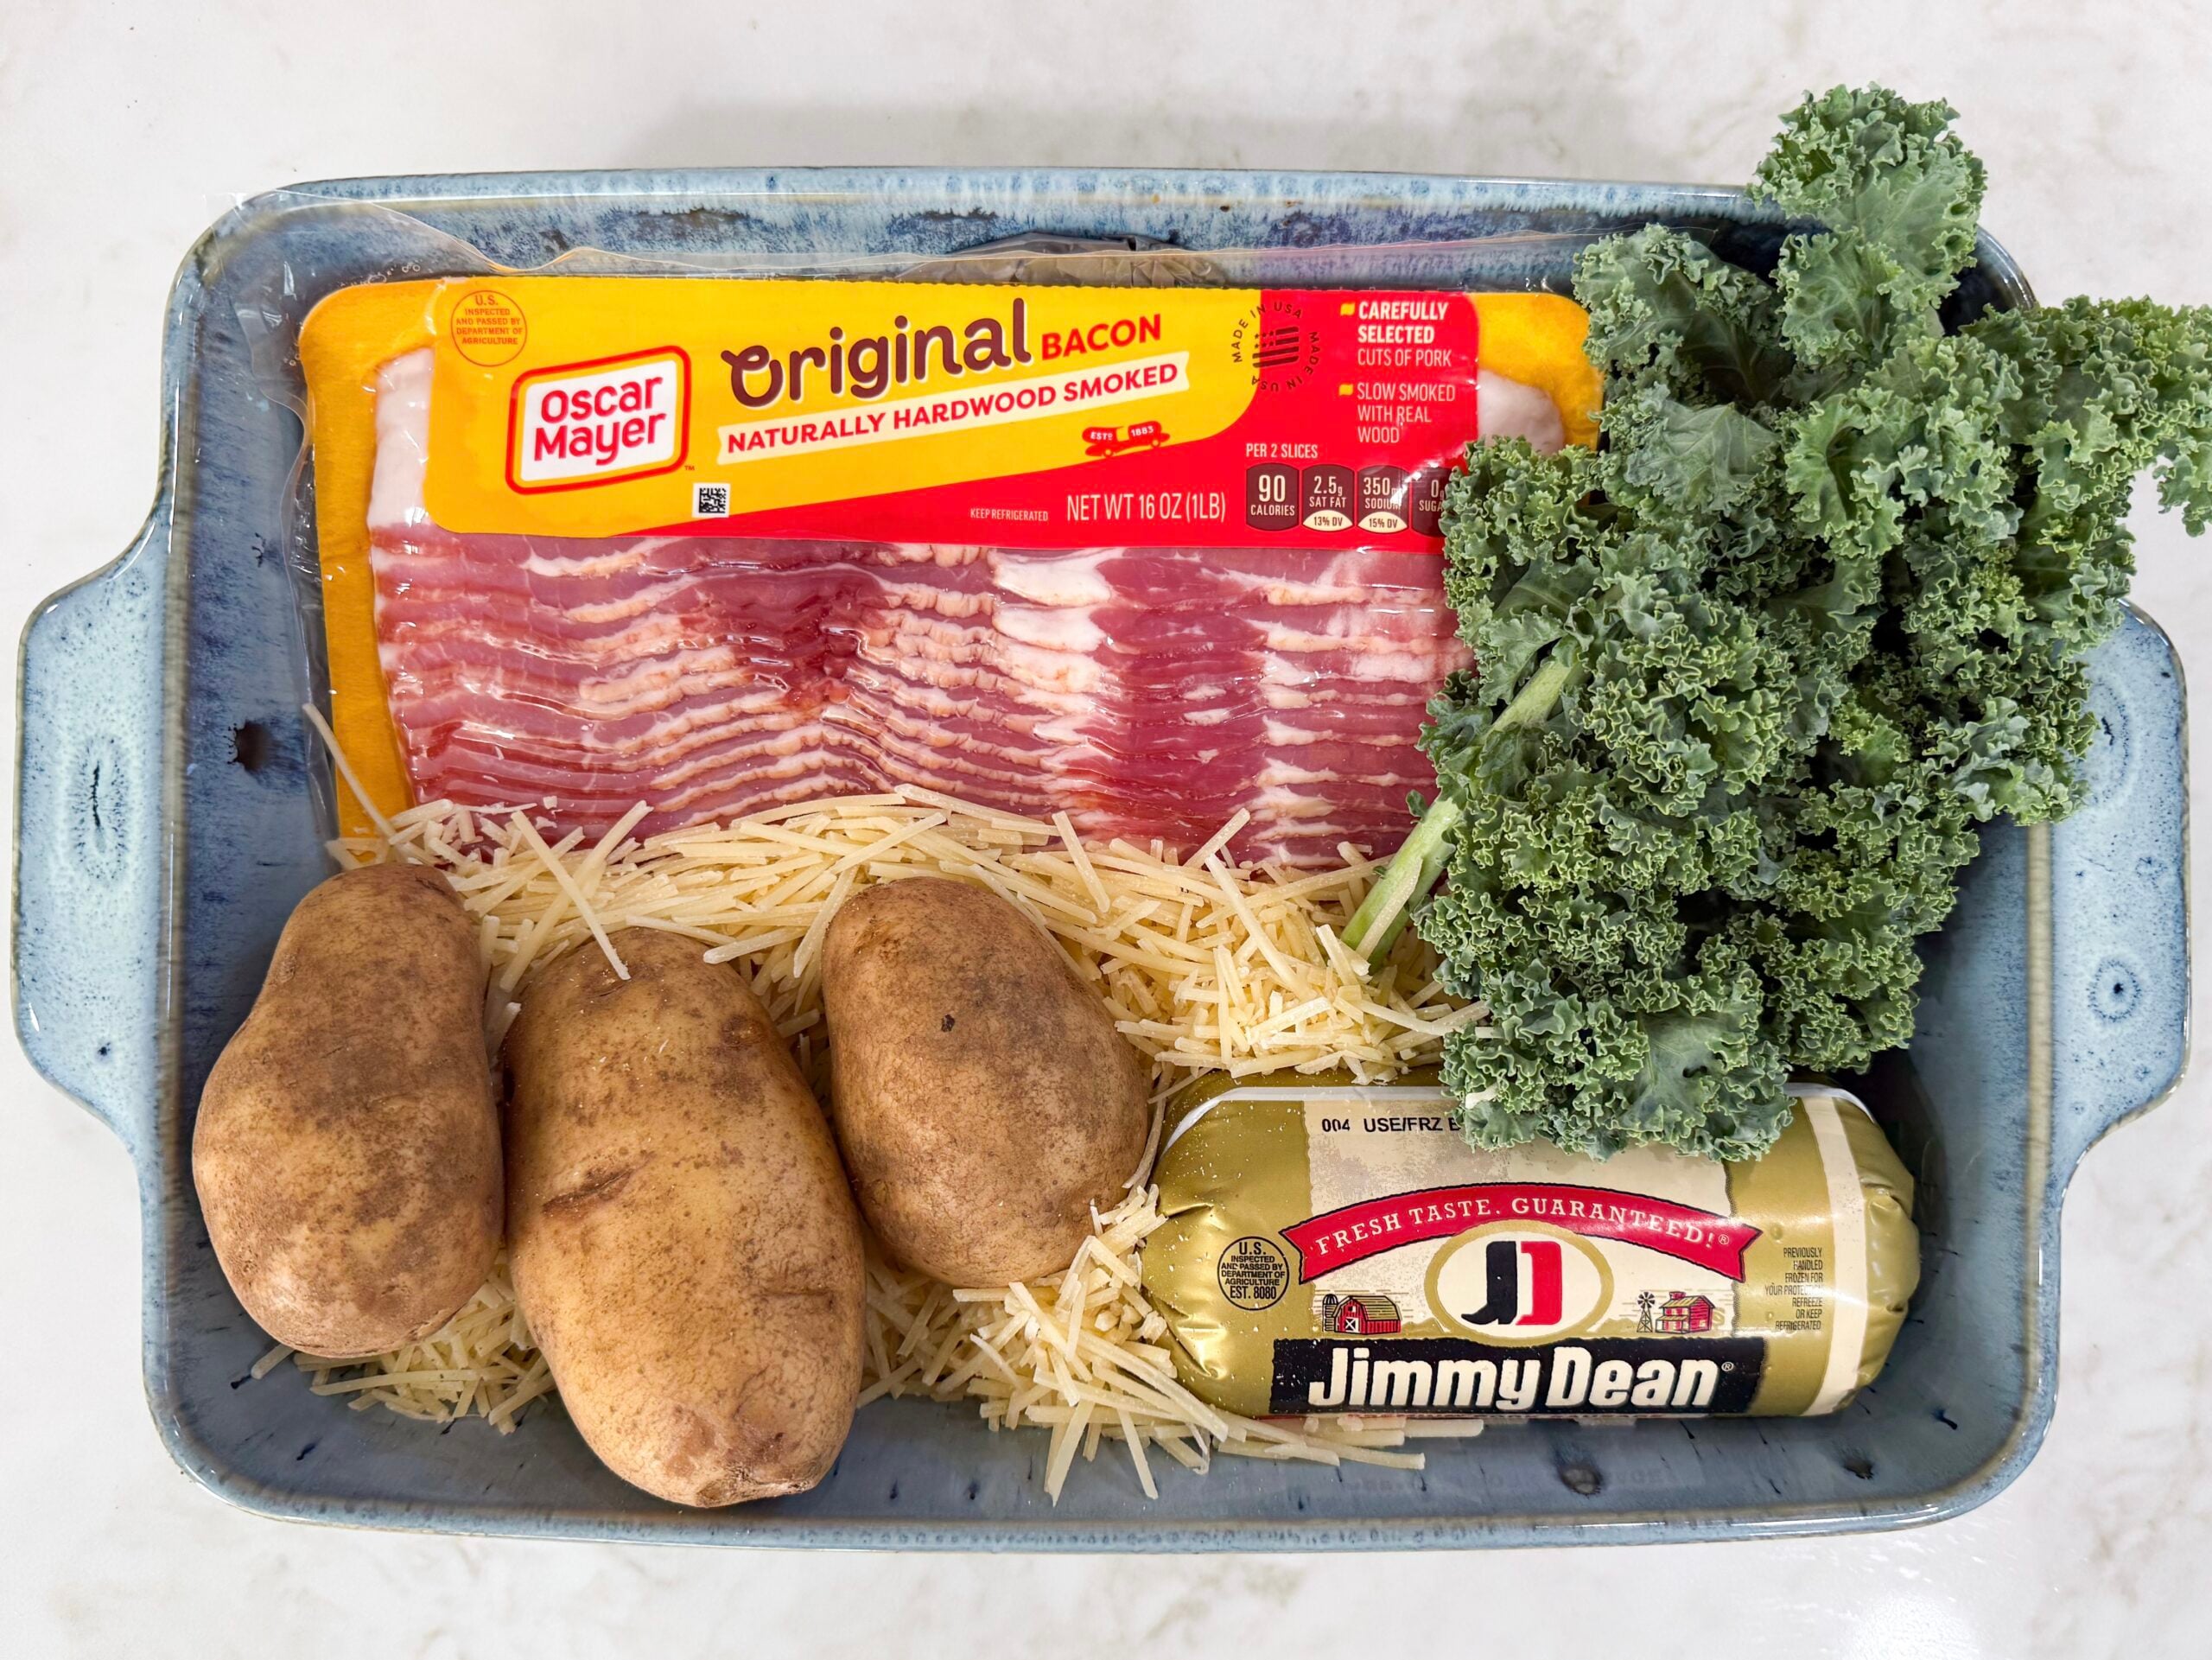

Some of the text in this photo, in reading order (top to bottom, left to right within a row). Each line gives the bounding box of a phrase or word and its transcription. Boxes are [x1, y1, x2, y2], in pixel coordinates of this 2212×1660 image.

[475, 295, 498, 305] U.S.
[1358, 302, 1448, 321] CAREFULLY
[1231, 302, 1302, 363] MADE IN USA
[1358, 326, 1434, 344] SELECTED
[721, 297, 1161, 407] Original BACON
[1357, 348, 1452, 367] CUTS OF PORK
[1251, 331, 1320, 391] MADE IN USA
[541, 376, 664, 424] Oscar
[1357, 383, 1456, 402] SLOW SMOKED
[728, 363, 1179, 454] NATURALLY HARDWOOD SMOKED
[1357, 405, 1432, 423] WITH REAL
[534, 412, 667, 466] Mayer
[1357, 426, 1400, 443] WOOD
[1246, 443, 1319, 458] PER 2 SLICES
[1258, 474, 1286, 502] 90
[1313, 476, 1343, 496] 2.5g
[1067, 492, 1226, 523] NET WT 16 OZ (1LB)
[1309, 497, 1346, 508] SAT FAT
[1419, 499, 1443, 512] SUGA
[970, 508, 1048, 521] KEEP REFRIGERATED
[1250, 505, 1295, 516] CALORIES
[1314, 517, 1343, 527] 13% DV
[1370, 518, 1398, 528] 15% DV
[1322, 1118, 1351, 1132] 004
[1363, 1117, 1443, 1132] USE/FRZ
[1315, 1212, 1402, 1255] FRESH
[1408, 1199, 1500, 1226] TASTE.
[1239, 1242, 1267, 1255] U.S.
[1783, 1247, 1822, 1258] PREVIOUSLY
[1793, 1260, 1822, 1270] HANDLED
[1785, 1272, 1823, 1283] FROZEN FOR
[1230, 1286, 1276, 1299] EST. 8080
[1765, 1285, 1783, 1295] YOUR
[1792, 1297, 1822, 1307] REFREEZE
[1796, 1309, 1822, 1319] OR KEEP
[1776, 1320, 1821, 1330] REFRIGERATED
[1307, 1347, 1541, 1410] Jimmy
